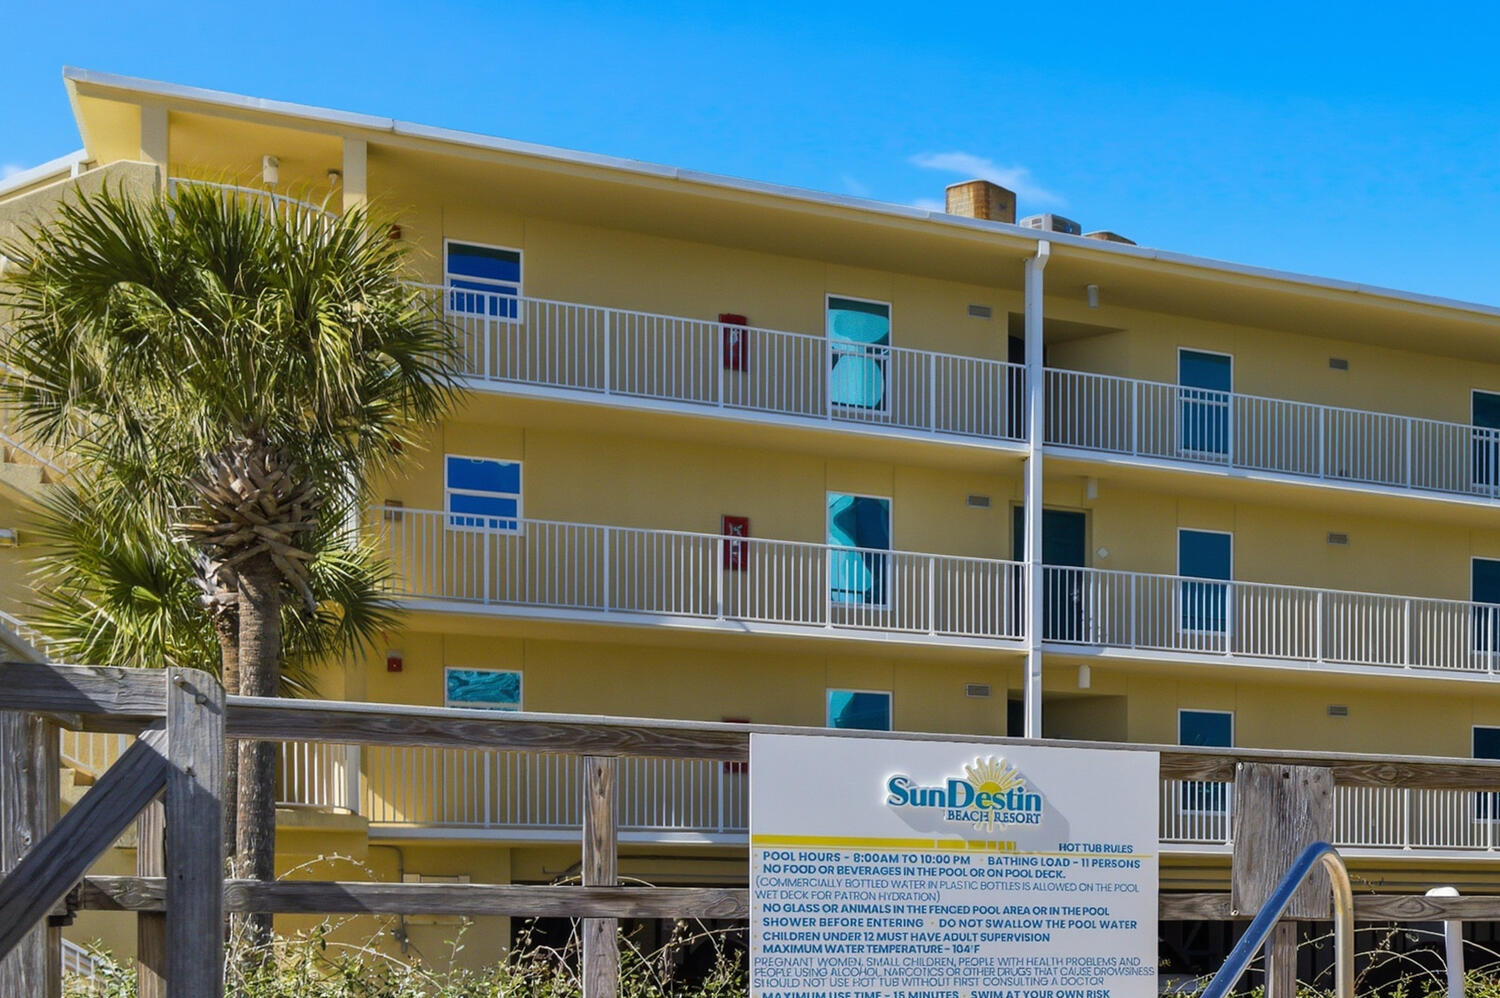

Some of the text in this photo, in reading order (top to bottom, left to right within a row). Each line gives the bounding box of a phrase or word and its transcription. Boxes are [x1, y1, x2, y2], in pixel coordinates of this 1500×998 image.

[888, 777, 1041, 811] SunDestin
[948, 810, 1040, 824] BEACH RESORT
[1059, 843, 1133, 853] HOT TUB RULES
[763, 852, 796, 861] POOL
[799, 852, 840, 862] HOURS
[854, 853, 898, 863] 8:00AM
[902, 854, 917, 864] TO
[921, 855, 950, 864] 10:00
[953, 856, 970, 865] PM
[988, 857, 1038, 866] BATHING
[1041, 858, 1070, 867] LOAD
[1082, 859, 1089, 867] 11
[1092, 859, 1140, 868] PERSONS
[763, 864, 1066, 879] NO FOOD OR BEVERAGES IN THE POOL OR ON POOL DECK.
[845, 879, 888, 888] BOTTLED
[891, 880, 925, 889] WATER
[928, 880, 937, 889] IN
[940, 881, 978, 890] PLASTIC
[980, 882, 1021, 891] BOTTLES
[1022, 883, 1030, 891] IS
[1032, 883, 1076, 892] ALLOWED
[1078, 883, 1094, 892] ON
[1096, 884, 1112, 892] THE
[1114, 884, 1139, 892] POOL
[755, 891, 940, 902] WET DECK FOR PATRON HYDRATION)
[763, 904, 1109, 916] NO GLASS OR ANIMALS IN THE FENCED POOL AREA OR IN THE POOL
[763, 918, 923, 927] SHOWER BEFORE ENTERING
[939, 919, 1137, 929] DO NOT SWALLOW THE POOL WATER
[763, 932, 1050, 942] CHILDREN UNDER 12 MUST HAVE ADULT SUPERVISION
[763, 945, 822, 954] MAXIMUM
[825, 945, 865, 954] WATER
[866, 945, 943, 954] TEMPERATURE
[755, 957, 814, 966] PREGNANT
[867, 958, 900, 966] SMALL
[959, 957, 995, 966] PEOPLE
[998, 958, 1024, 966] WITH
[1026, 958, 1063, 966] HEALTH
[1066, 957, 1117, 966] PROBLEMS
[1120, 957, 1141, 966] AND
[755, 968, 792, 976] PEOPLE
[795, 968, 827, 976] USING
[884, 968, 944, 976] NARCOTICS
[946, 968, 960, 976] OR
[963, 968, 995, 976] OTHER
[998, 967, 1031, 976] DRUGS
[1034, 967, 1058, 975] THAT
[1060, 967, 1091, 976] CAUSE
[754, 979, 800, 987] SHOULD
[803, 978, 826, 987] NOT
[830, 978, 849, 987] USE
[902, 978, 952, 986] WITHOUT
[954, 977, 980, 986] FIRST
[983, 977, 1048, 986] CONSULTING
[1061, 977, 1104, 986] DOCTOR
[971, 990, 1110, 998] SWIM AT YOUR OWN RISK
